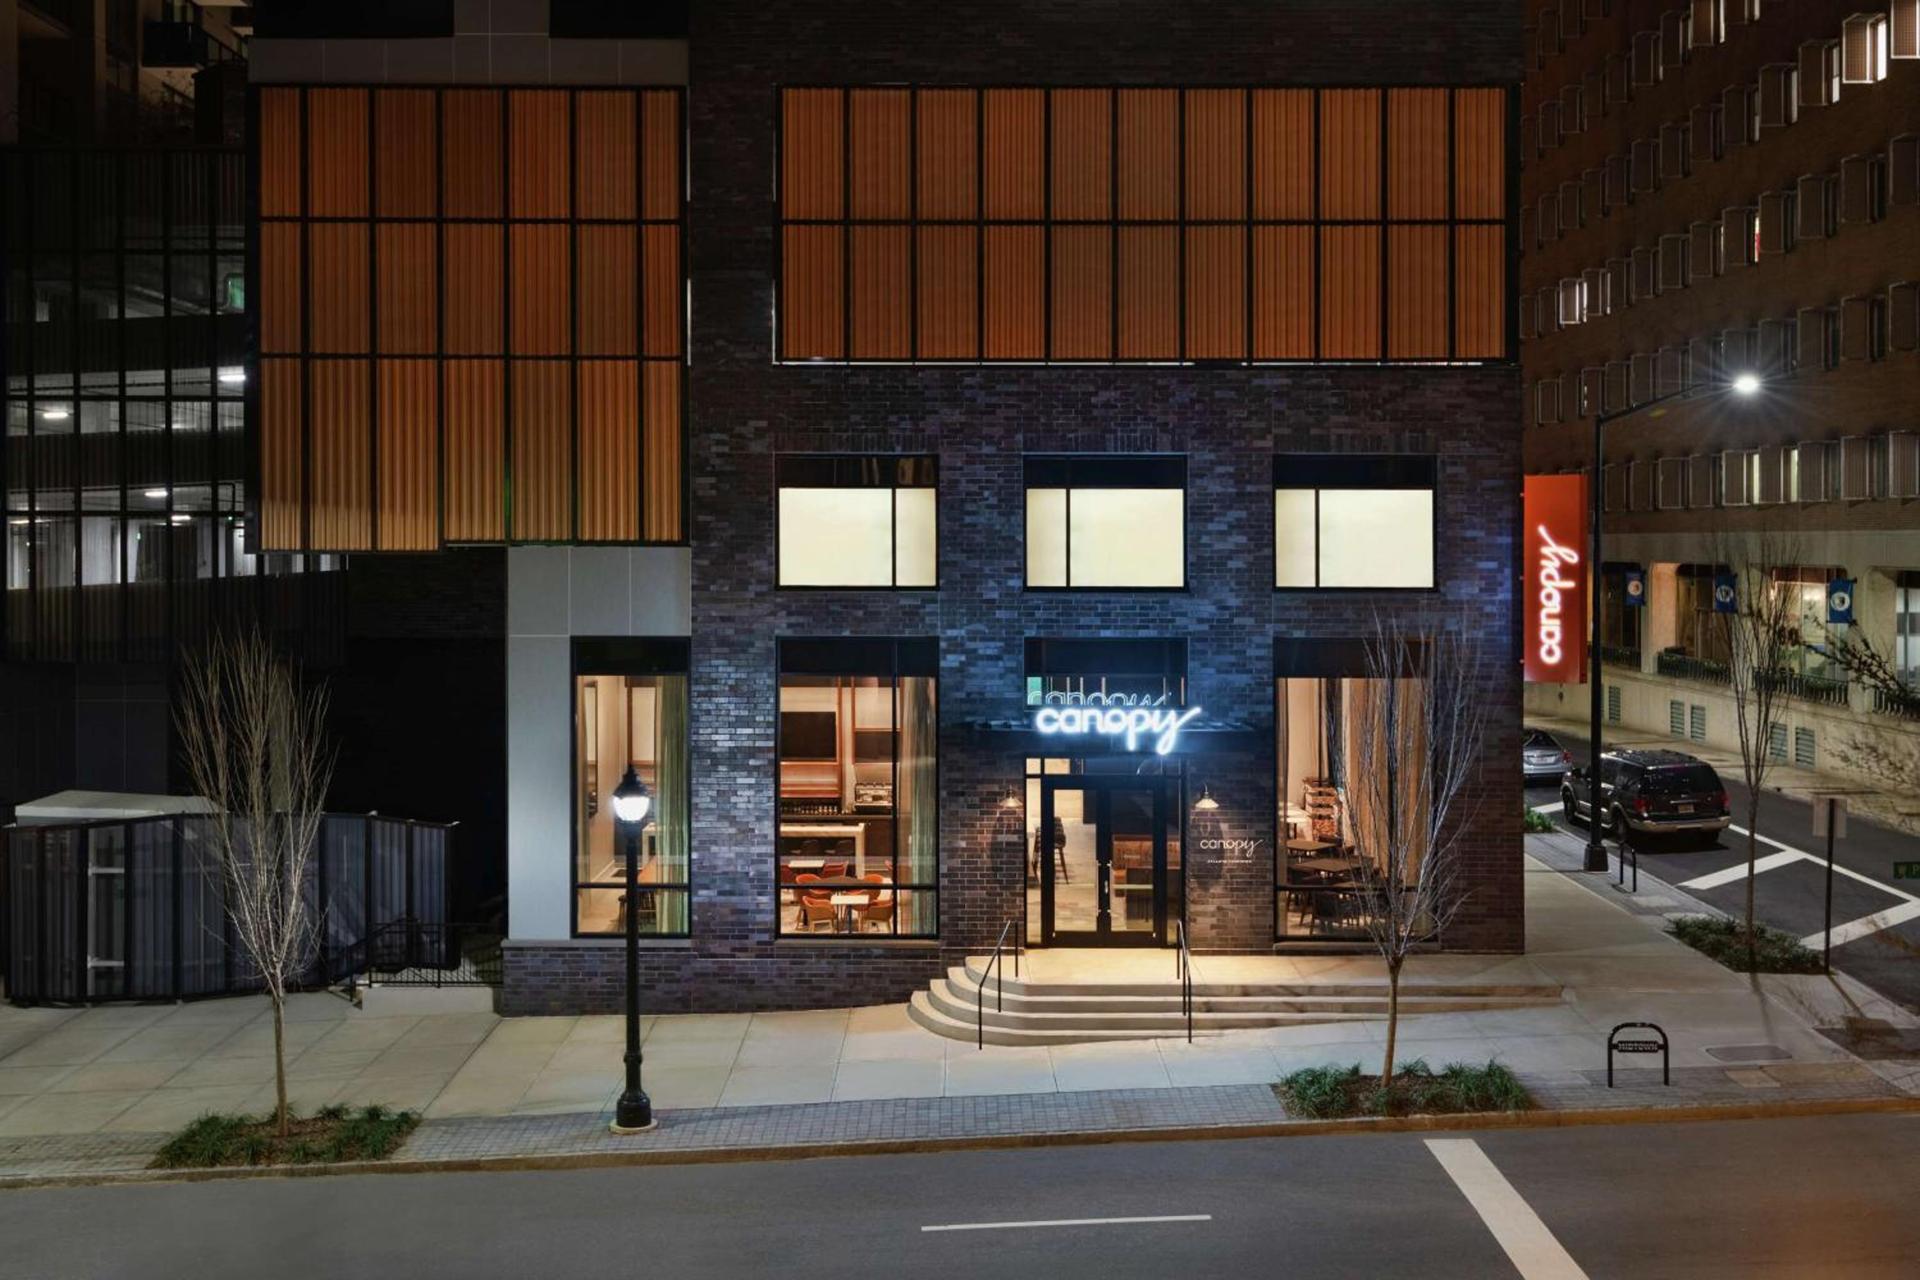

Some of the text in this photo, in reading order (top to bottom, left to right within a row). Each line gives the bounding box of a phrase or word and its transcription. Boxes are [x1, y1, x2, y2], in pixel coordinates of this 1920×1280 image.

[1538, 525, 1580, 665] canopy
[1036, 706, 1202, 755] canopy
[1200, 839, 1263, 858] canopy
